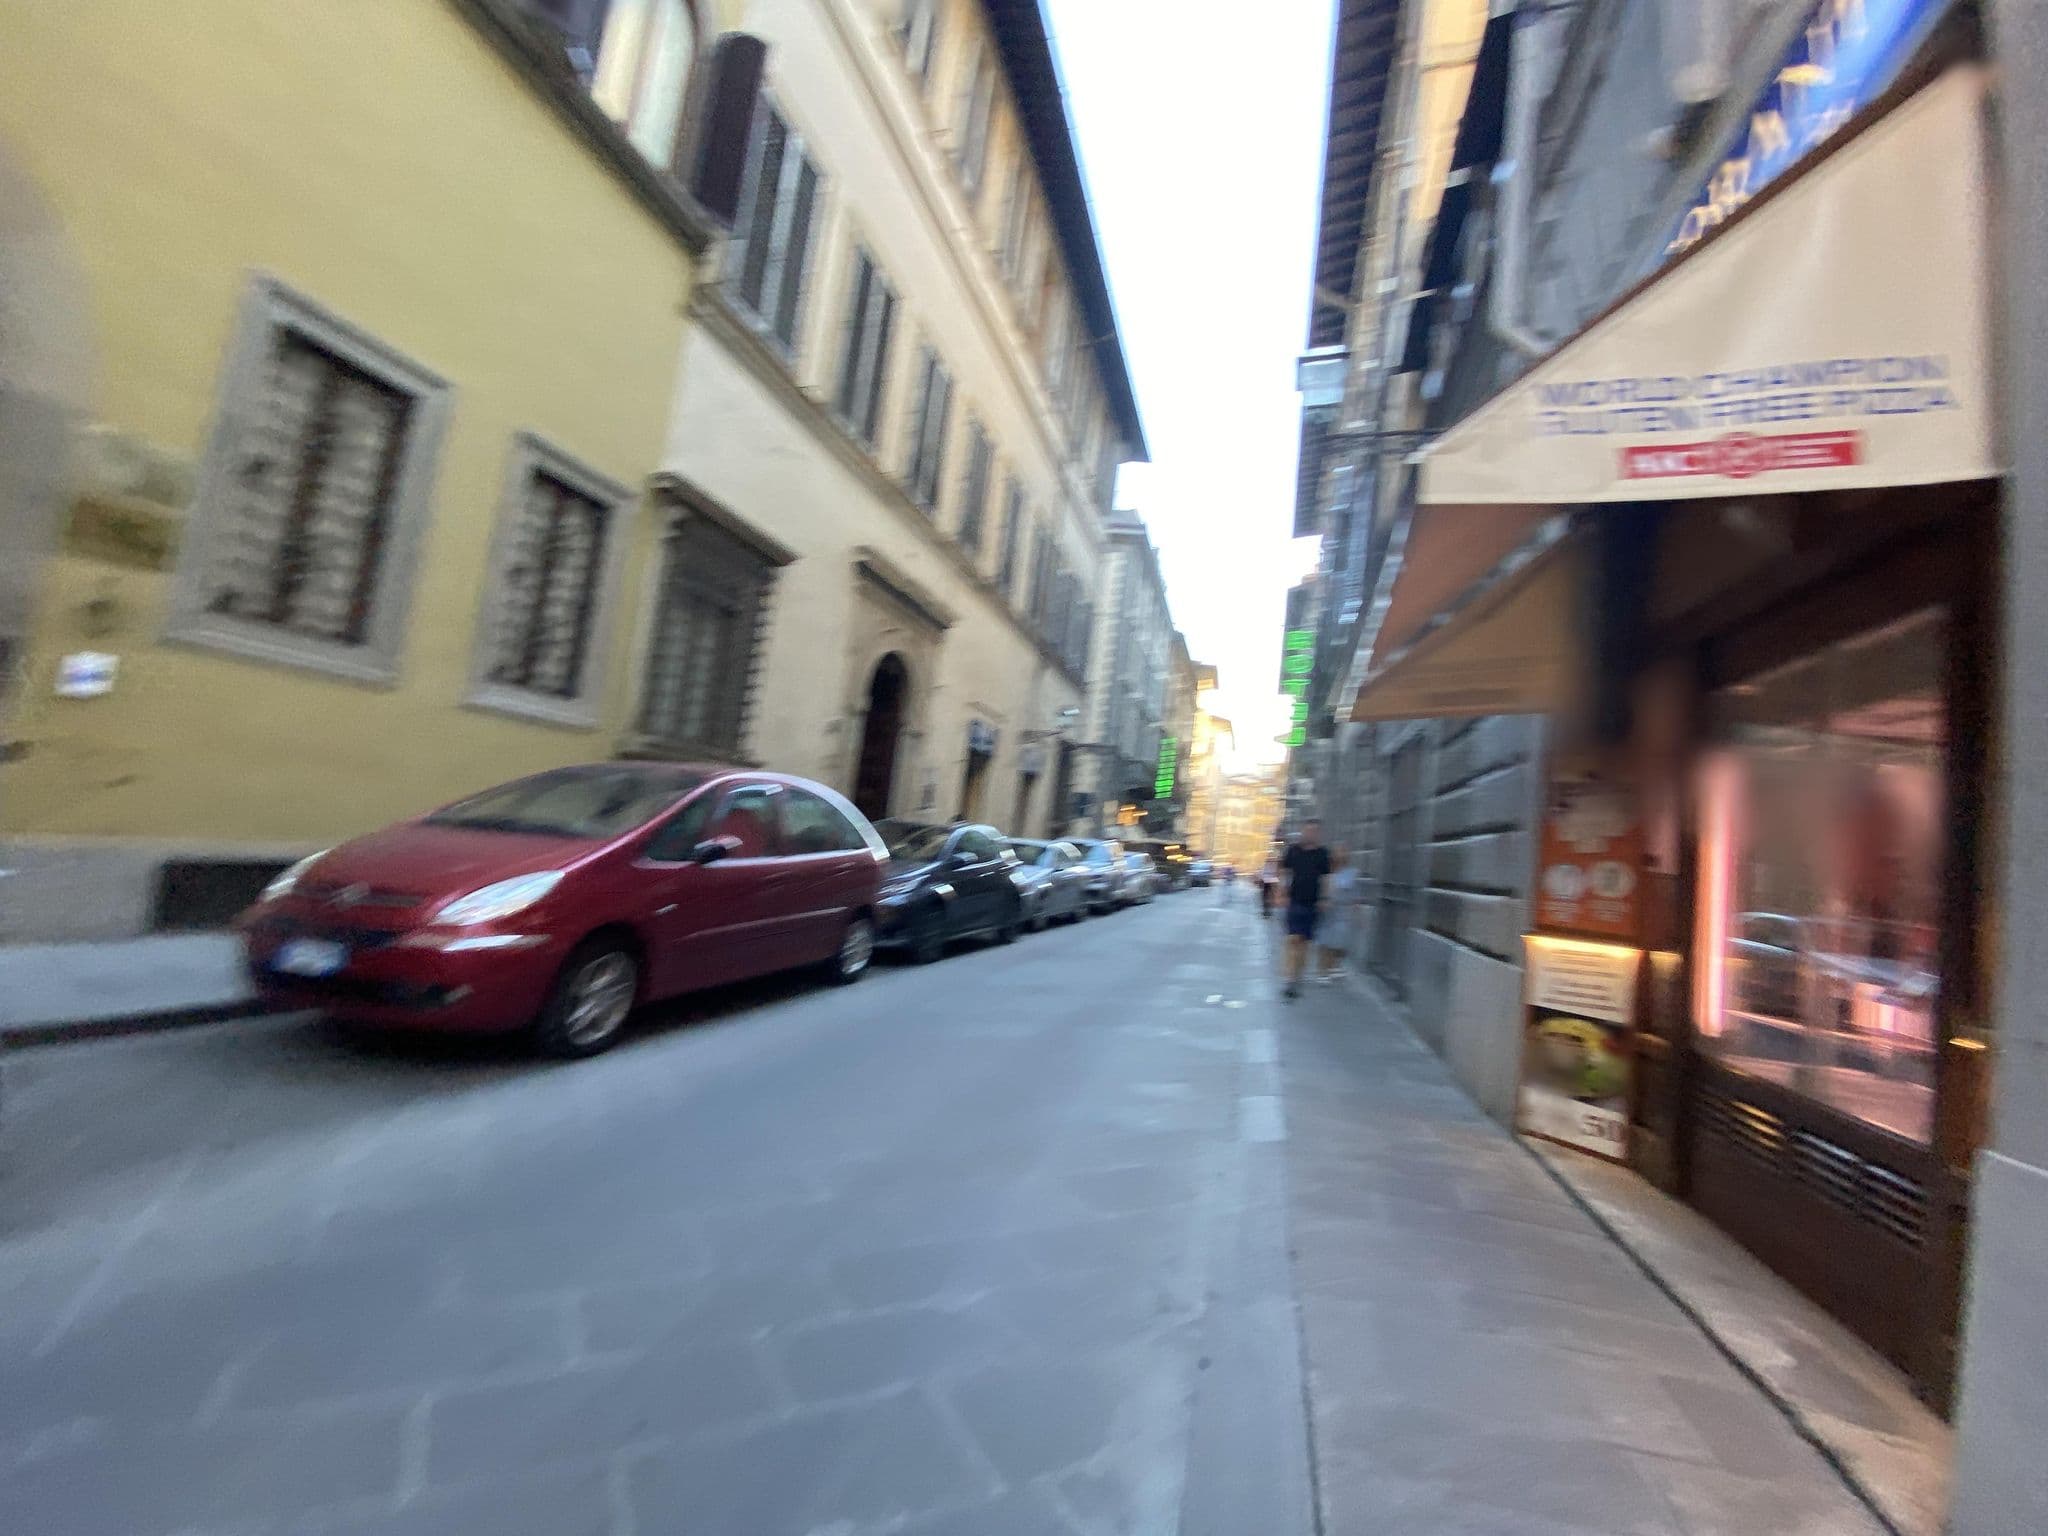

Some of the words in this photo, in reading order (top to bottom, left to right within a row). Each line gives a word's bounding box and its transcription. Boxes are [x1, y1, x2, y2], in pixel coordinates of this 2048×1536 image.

[1538, 375, 1690, 406] WORLD
[1697, 354, 1949, 399] CHAMPION
[1703, 391, 1819, 428] FREE
[1829, 385, 1961, 418] PIZZA
